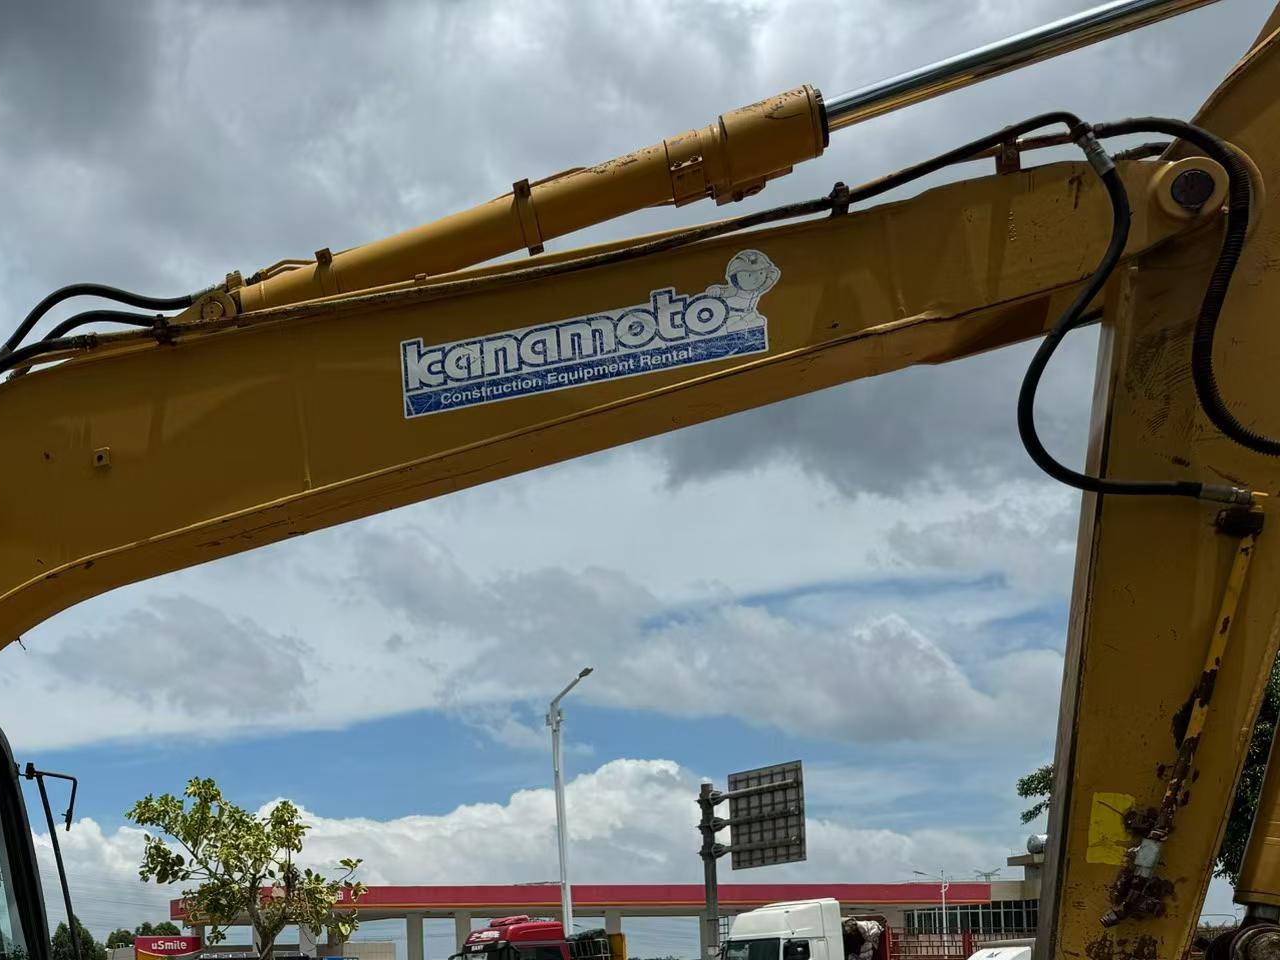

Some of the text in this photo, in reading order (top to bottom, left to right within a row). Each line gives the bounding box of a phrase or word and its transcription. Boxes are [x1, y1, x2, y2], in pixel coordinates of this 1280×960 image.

[406, 289, 731, 391] kanamoto
[439, 348, 693, 405] Construction Equipment Rental
[151, 940, 188, 951] uSmile
